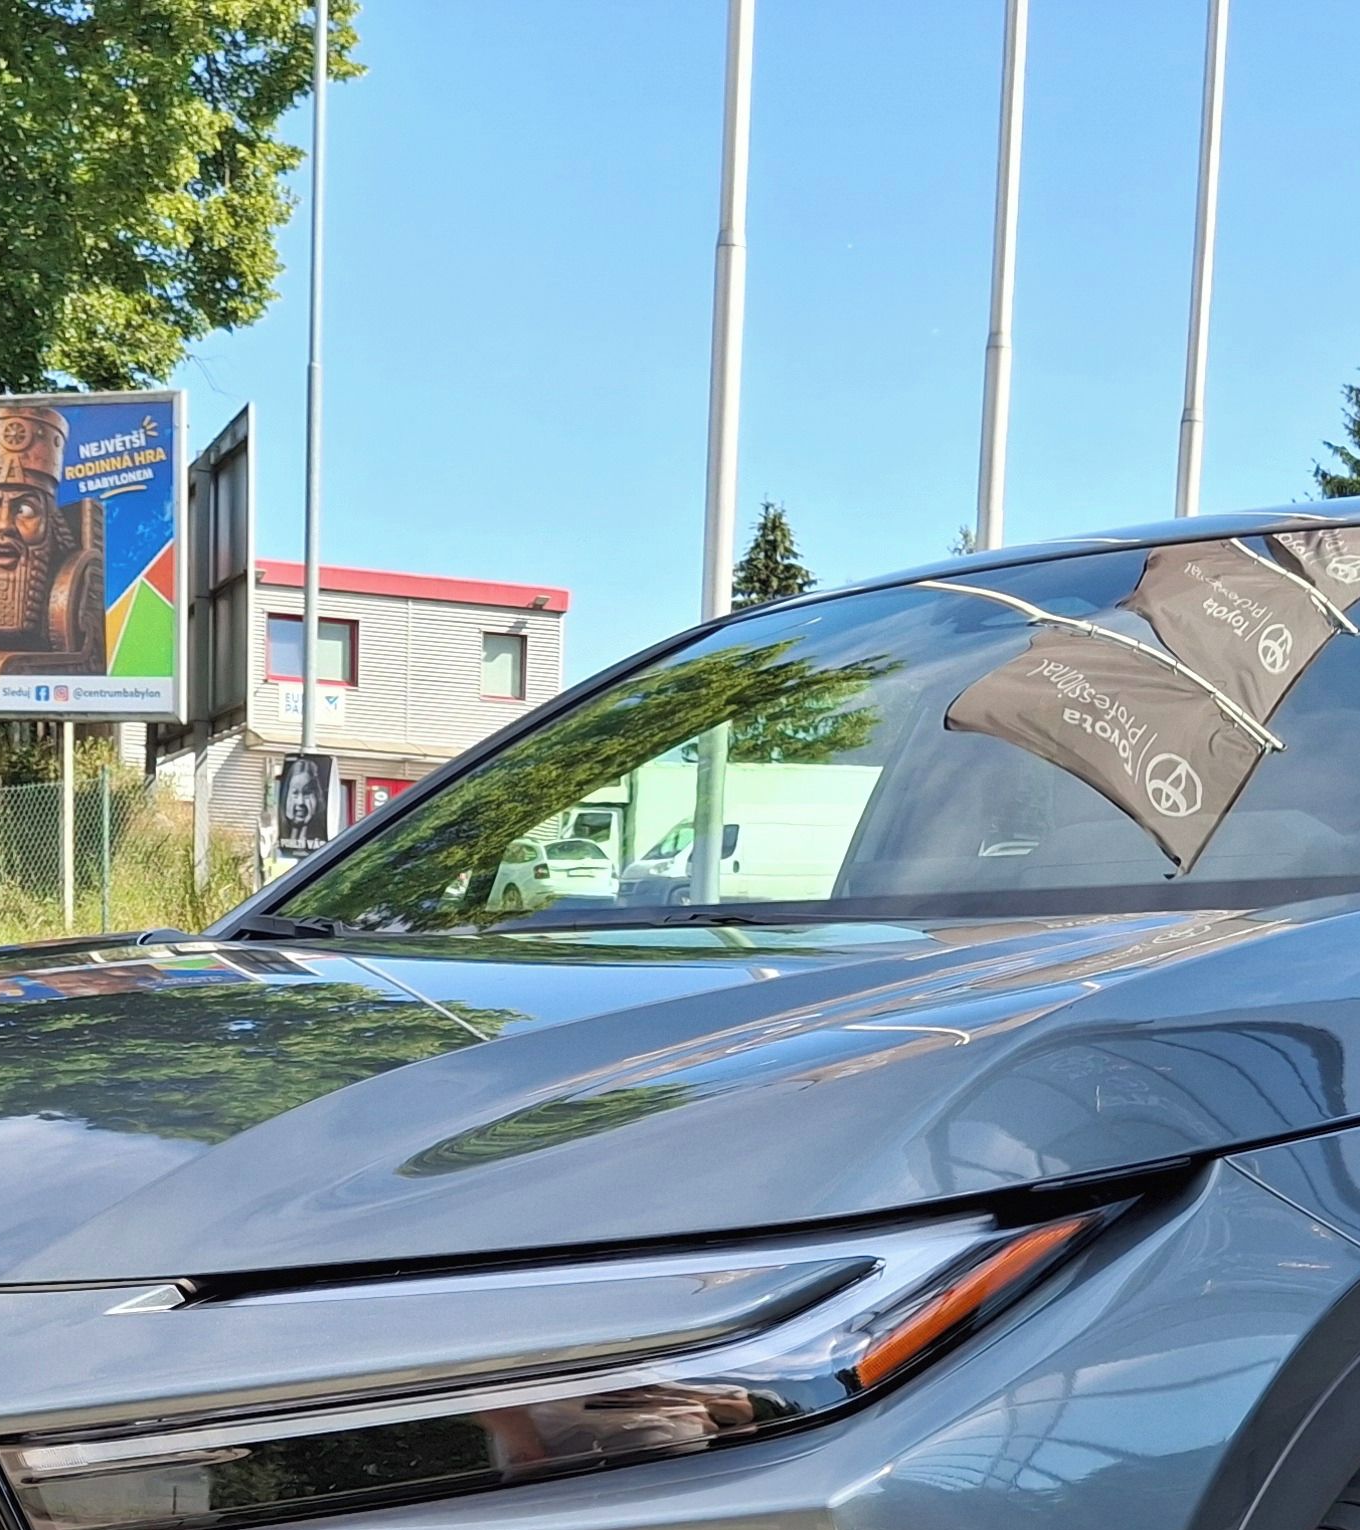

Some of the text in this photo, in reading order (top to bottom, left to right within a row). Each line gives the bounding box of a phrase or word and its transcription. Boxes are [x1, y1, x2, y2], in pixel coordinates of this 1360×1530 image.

[79, 429, 147, 459] NEJVĚTŠÍ
[65, 447, 166, 480] RODINNÁ HRA
[79, 468, 154, 493] S BABYLONEM
[73, 687, 161, 699] @centrumbabylon
[1027, 658, 1148, 746] Professional
[1062, 707, 1133, 776] Toyota
